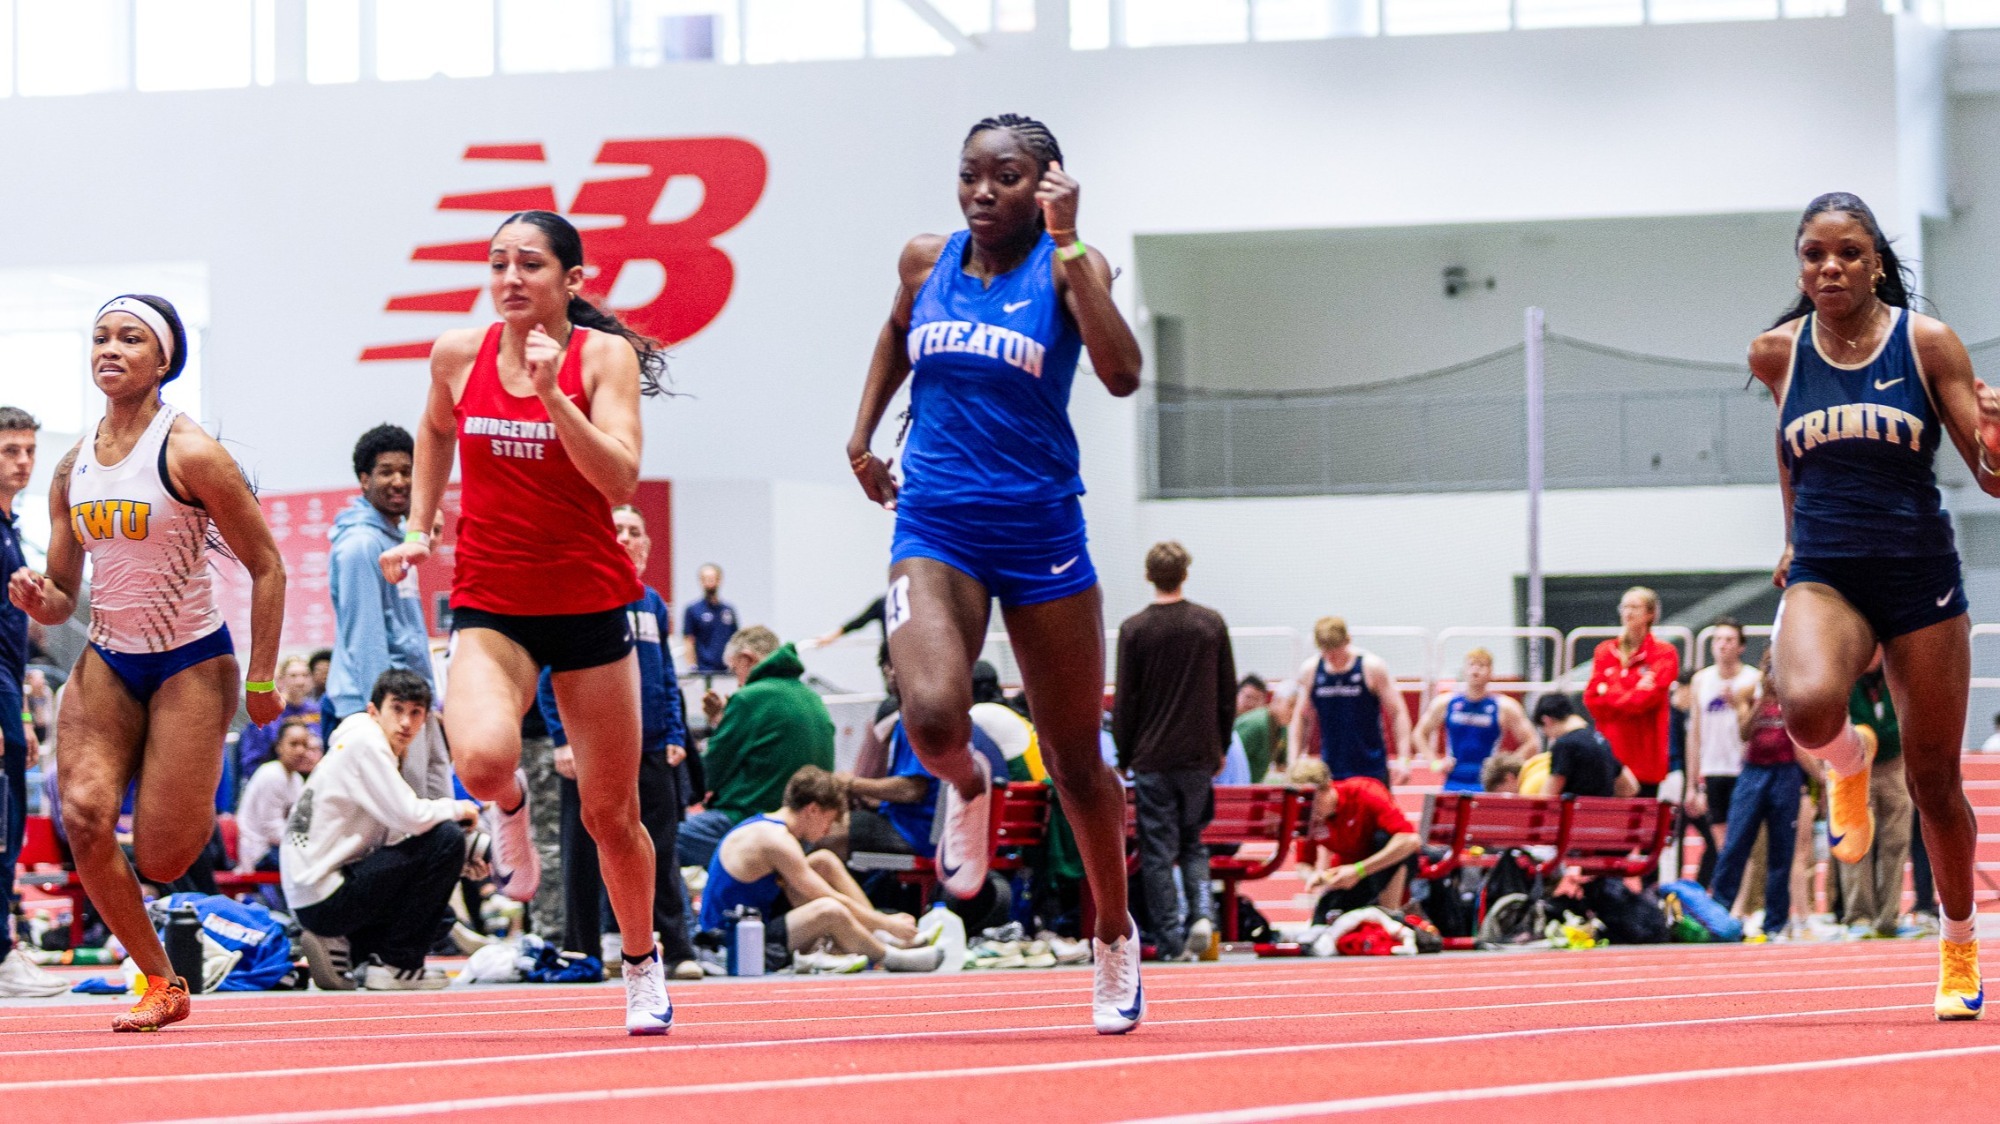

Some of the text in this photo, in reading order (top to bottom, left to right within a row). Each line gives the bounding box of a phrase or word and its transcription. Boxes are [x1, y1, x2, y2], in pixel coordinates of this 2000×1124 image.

[359, 136, 769, 362] NB
[907, 320, 1046, 379] WHEATON
[490, 438, 545, 460] STATE
[1784, 402, 1924, 458] TRINITY
